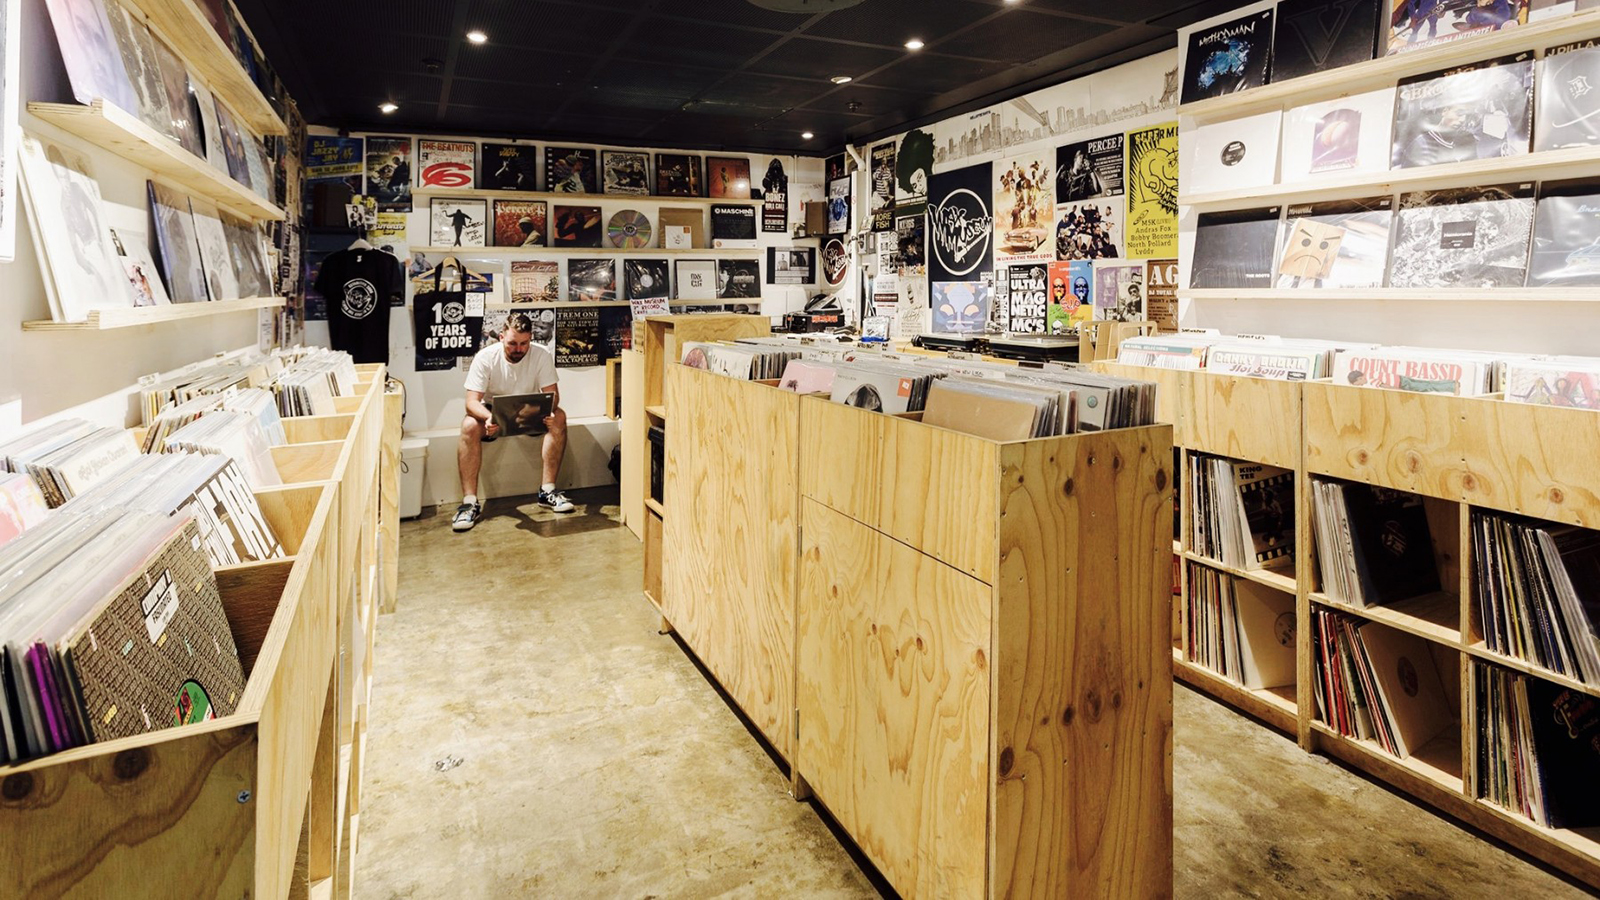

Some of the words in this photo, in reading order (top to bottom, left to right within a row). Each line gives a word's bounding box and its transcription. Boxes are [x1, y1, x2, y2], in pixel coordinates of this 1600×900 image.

[422, 141, 436, 150] THE
[437, 142, 474, 153] BEATNUTS
[1088, 138, 1117, 153] PERCEE
[496, 204, 533, 214] Percee
[876, 221, 890, 229] FISH
[1010, 280, 1046, 290] ULTRA
[1010, 291, 1046, 305] MAG
[1010, 304, 1046, 317] NETIC
[430, 324, 466, 337] YEARS
[1010, 318, 1045, 333] MC'S
[425, 337, 439, 350] OF
[441, 336, 472, 349] DOPE
[1215, 352, 1256, 366] DANNY
[1260, 354, 1305, 370] BROWN
[1349, 356, 1401, 376] COUNT
[1253, 365, 1286, 378] Soup
